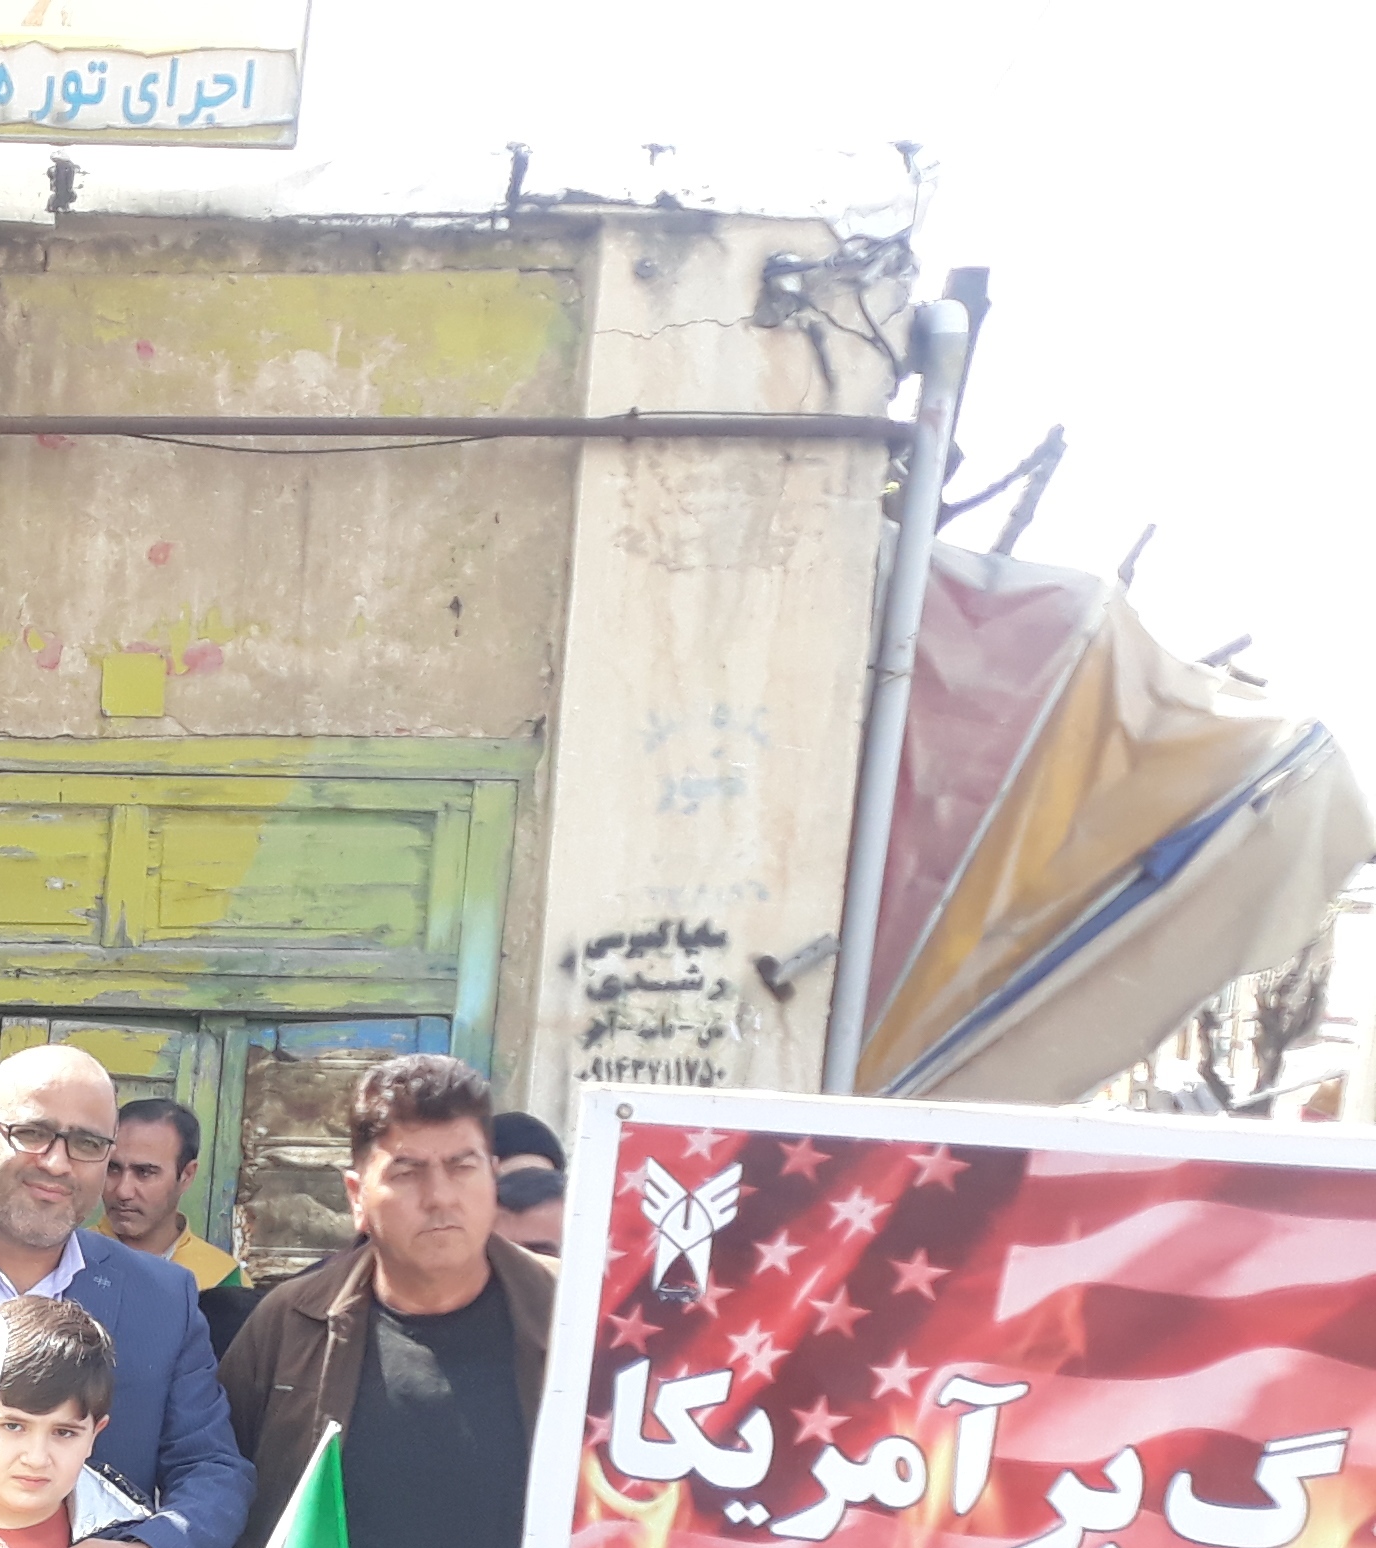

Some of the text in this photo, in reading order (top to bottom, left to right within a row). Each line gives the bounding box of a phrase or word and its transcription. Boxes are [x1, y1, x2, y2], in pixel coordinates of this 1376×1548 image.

[29, 61, 106, 121] تور
[123, 57, 255, 126] اجرای
[609, 1359, 1031, 1541] آمریکا
